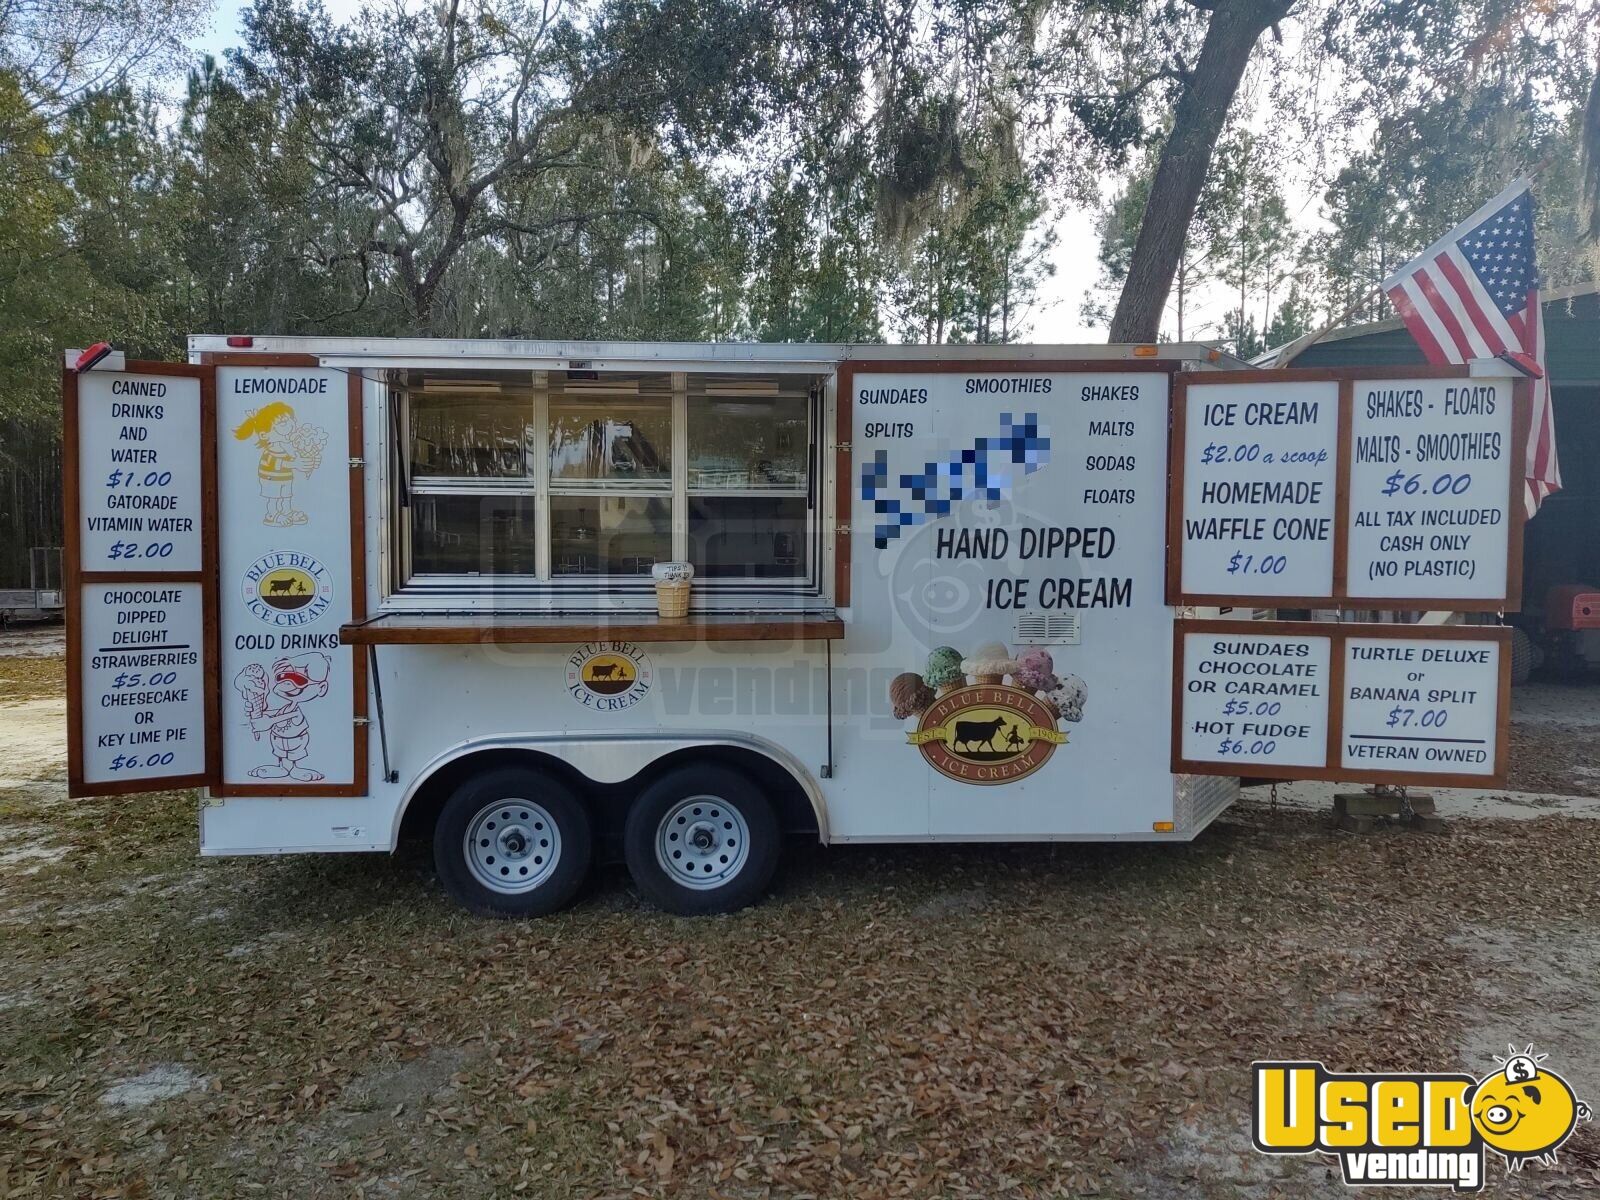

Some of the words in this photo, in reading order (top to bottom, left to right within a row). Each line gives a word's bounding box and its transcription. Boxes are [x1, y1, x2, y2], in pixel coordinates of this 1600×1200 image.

[112, 381, 166, 397] CANNED
[235, 378, 328, 393] LEMONDADE
[966, 379, 1051, 393] SMOOTHIES
[1082, 386, 1139, 401] SHAKES
[860, 389, 927, 404] SUNDAES
[1367, 390, 1422, 419] SHAKES
[1445, 387, 1495, 415] FLOATS
[112, 403, 163, 419] DRINKS
[1204, 404, 1237, 426] ICE
[1245, 402, 1318, 425] CREAM
[120, 426, 147, 441] AND
[865, 423, 913, 438] SPLITS
[1089, 421, 1134, 436] MALTS
[112, 449, 156, 463] WATER
[1201, 442, 1259, 465] $2.00
[1263, 453, 1274, 463] a
[1280, 449, 1328, 467] scoop
[1357, 435, 1400, 463] MALTS
[1417, 432, 1500, 462] SMOOTHIES
[1086, 456, 1135, 471] SODAS
[106, 469, 171, 488] $1.00
[1381, 469, 1471, 497] $6.00
[1084, 489, 1135, 504] FLOATS
[1202, 482, 1322, 504] HOMEMADE
[108, 495, 178, 510] GATORADE
[88, 517, 142, 531] VITAMIN
[148, 518, 192, 532] WATER
[1355, 512, 1380, 527] ALL
[1387, 511, 1416, 527] TAX
[1421, 509, 1501, 525] INCLUDED
[1186, 518, 1266, 540] WAFFLE
[1273, 518, 1331, 540] CONE
[108, 541, 173, 560] $2.00
[937, 528, 1008, 560] HAND
[1019, 527, 1115, 559] DIPPED
[1380, 536, 1423, 551] CASH
[1430, 535, 1470, 550] ONLY
[246, 554, 285, 582] BLUE
[290, 554, 324, 581] BELL
[1227, 550, 1286, 575] $1.00
[1369, 561, 1397, 580] (NO
[1405, 560, 1475, 579] PLASTIC)
[104, 591, 182, 604] CHOCOLATE
[987, 579, 1029, 609] ICE
[1039, 578, 1132, 609] CREAM
[118, 611, 166, 624] DIPPED
[247, 599, 272, 621] ICE
[274, 597, 329, 625] CREAM
[113, 630, 168, 644] DELIGHT
[235, 635, 274, 649] COLD
[281, 634, 338, 649] DRINKS
[570, 642, 607, 668] BLUE
[612, 642, 644, 664] BELL
[1213, 642, 1309, 656] SUNDAES
[1352, 647, 1415, 661] TURTLE
[1422, 649, 1490, 663] DELUXE
[92, 652, 197, 669] STRAWBERRIES
[1199, 661, 1317, 676] CHOCOLATE
[112, 672, 176, 689] $5.00
[1408, 673, 1424, 681] or
[569, 683, 593, 705] ICE
[596, 681, 649, 709] CREAM
[1188, 680, 1216, 692] OR
[1225, 682, 1319, 696] CARAMEL
[1350, 687, 1419, 701] BANANA
[1428, 690, 1477, 704] SPLIT
[102, 689, 188, 707] CHEESECAKE
[938, 692, 984, 716] BLUE
[994, 692, 1036, 715] BELL
[1222, 698, 1281, 716] $5.00
[135, 712, 153, 724] OR
[1386, 705, 1447, 728] $7.00
[98, 734, 125, 747] KEY
[130, 730, 161, 744] LIME
[167, 728, 187, 741] PIE
[1195, 721, 1234, 734] HOT
[1243, 724, 1310, 737] FUDGE
[1218, 737, 1275, 755] $6.00
[1348, 745, 1419, 759] VETERAN
[1426, 748, 1486, 763] OWNED
[109, 752, 174, 771] $6.00
[942, 757, 969, 775] ICE
[977, 755, 1035, 779] CREAM
